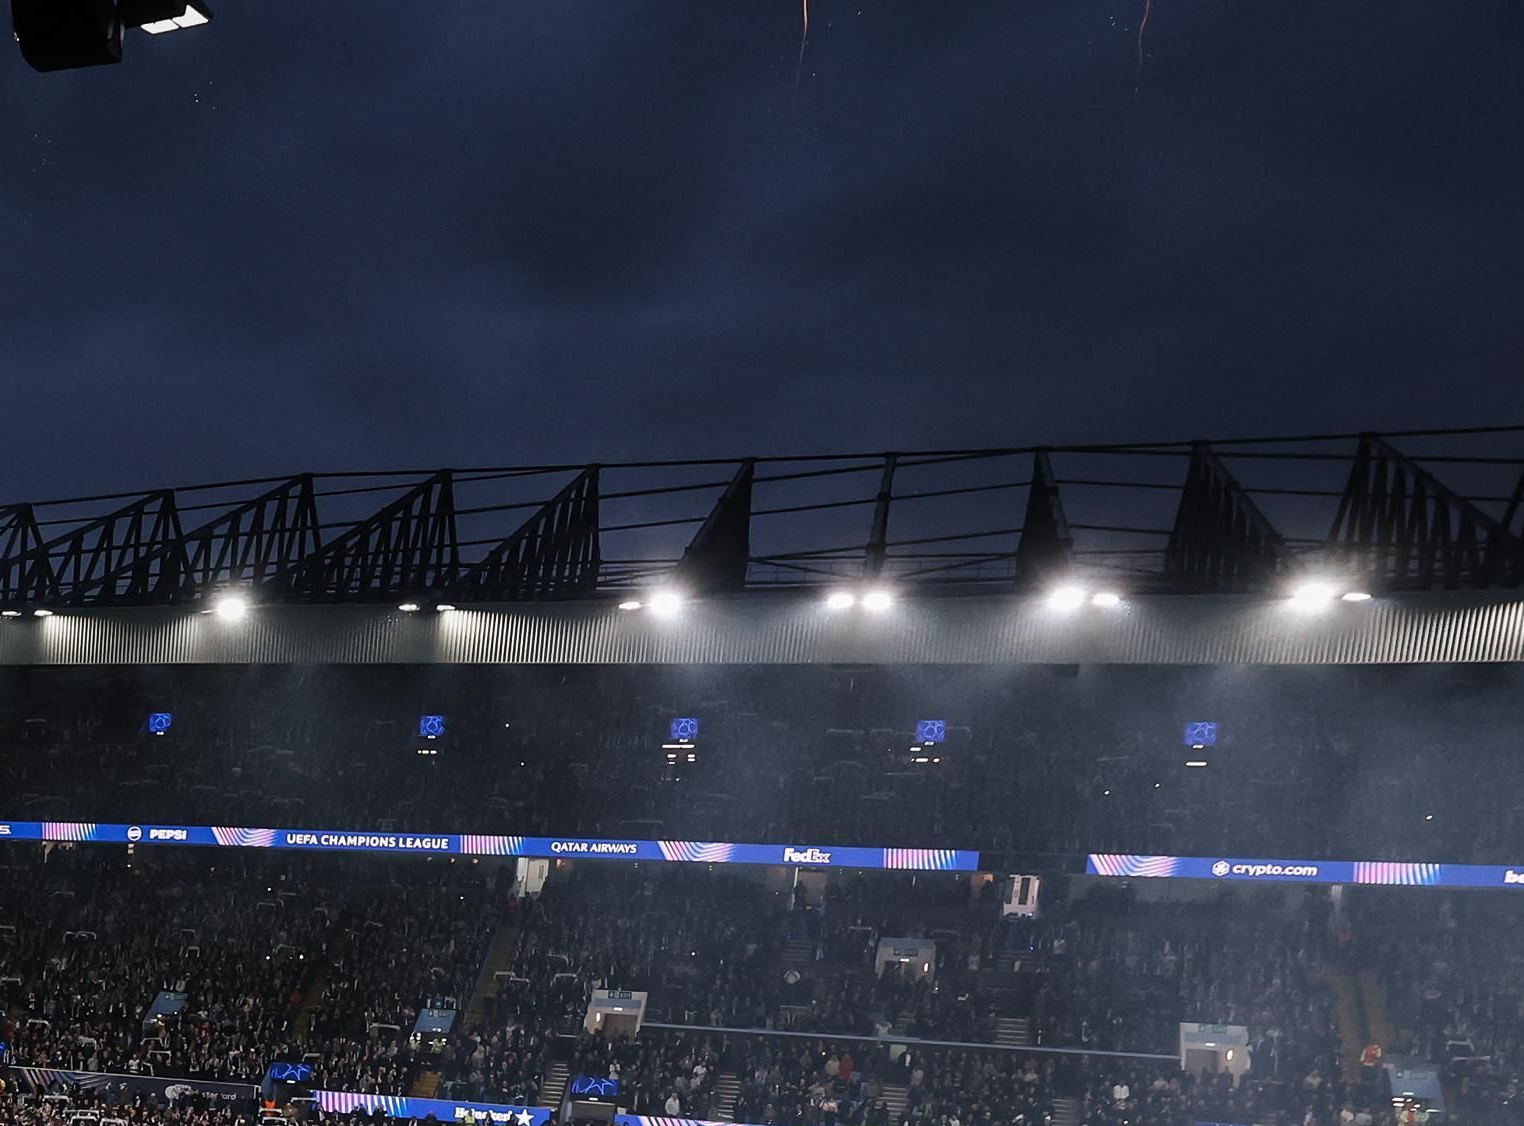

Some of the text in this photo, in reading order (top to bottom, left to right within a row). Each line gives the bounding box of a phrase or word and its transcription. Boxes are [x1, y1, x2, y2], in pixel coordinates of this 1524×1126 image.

[149, 828, 187, 840] PEPSI
[286, 834, 449, 850] UEFA CHAMPIONS LEAGUE
[551, 842, 637, 854] QATAR AIRWAYS
[783, 847, 832, 864] FedEx
[1232, 863, 1319, 876] crypto.com
